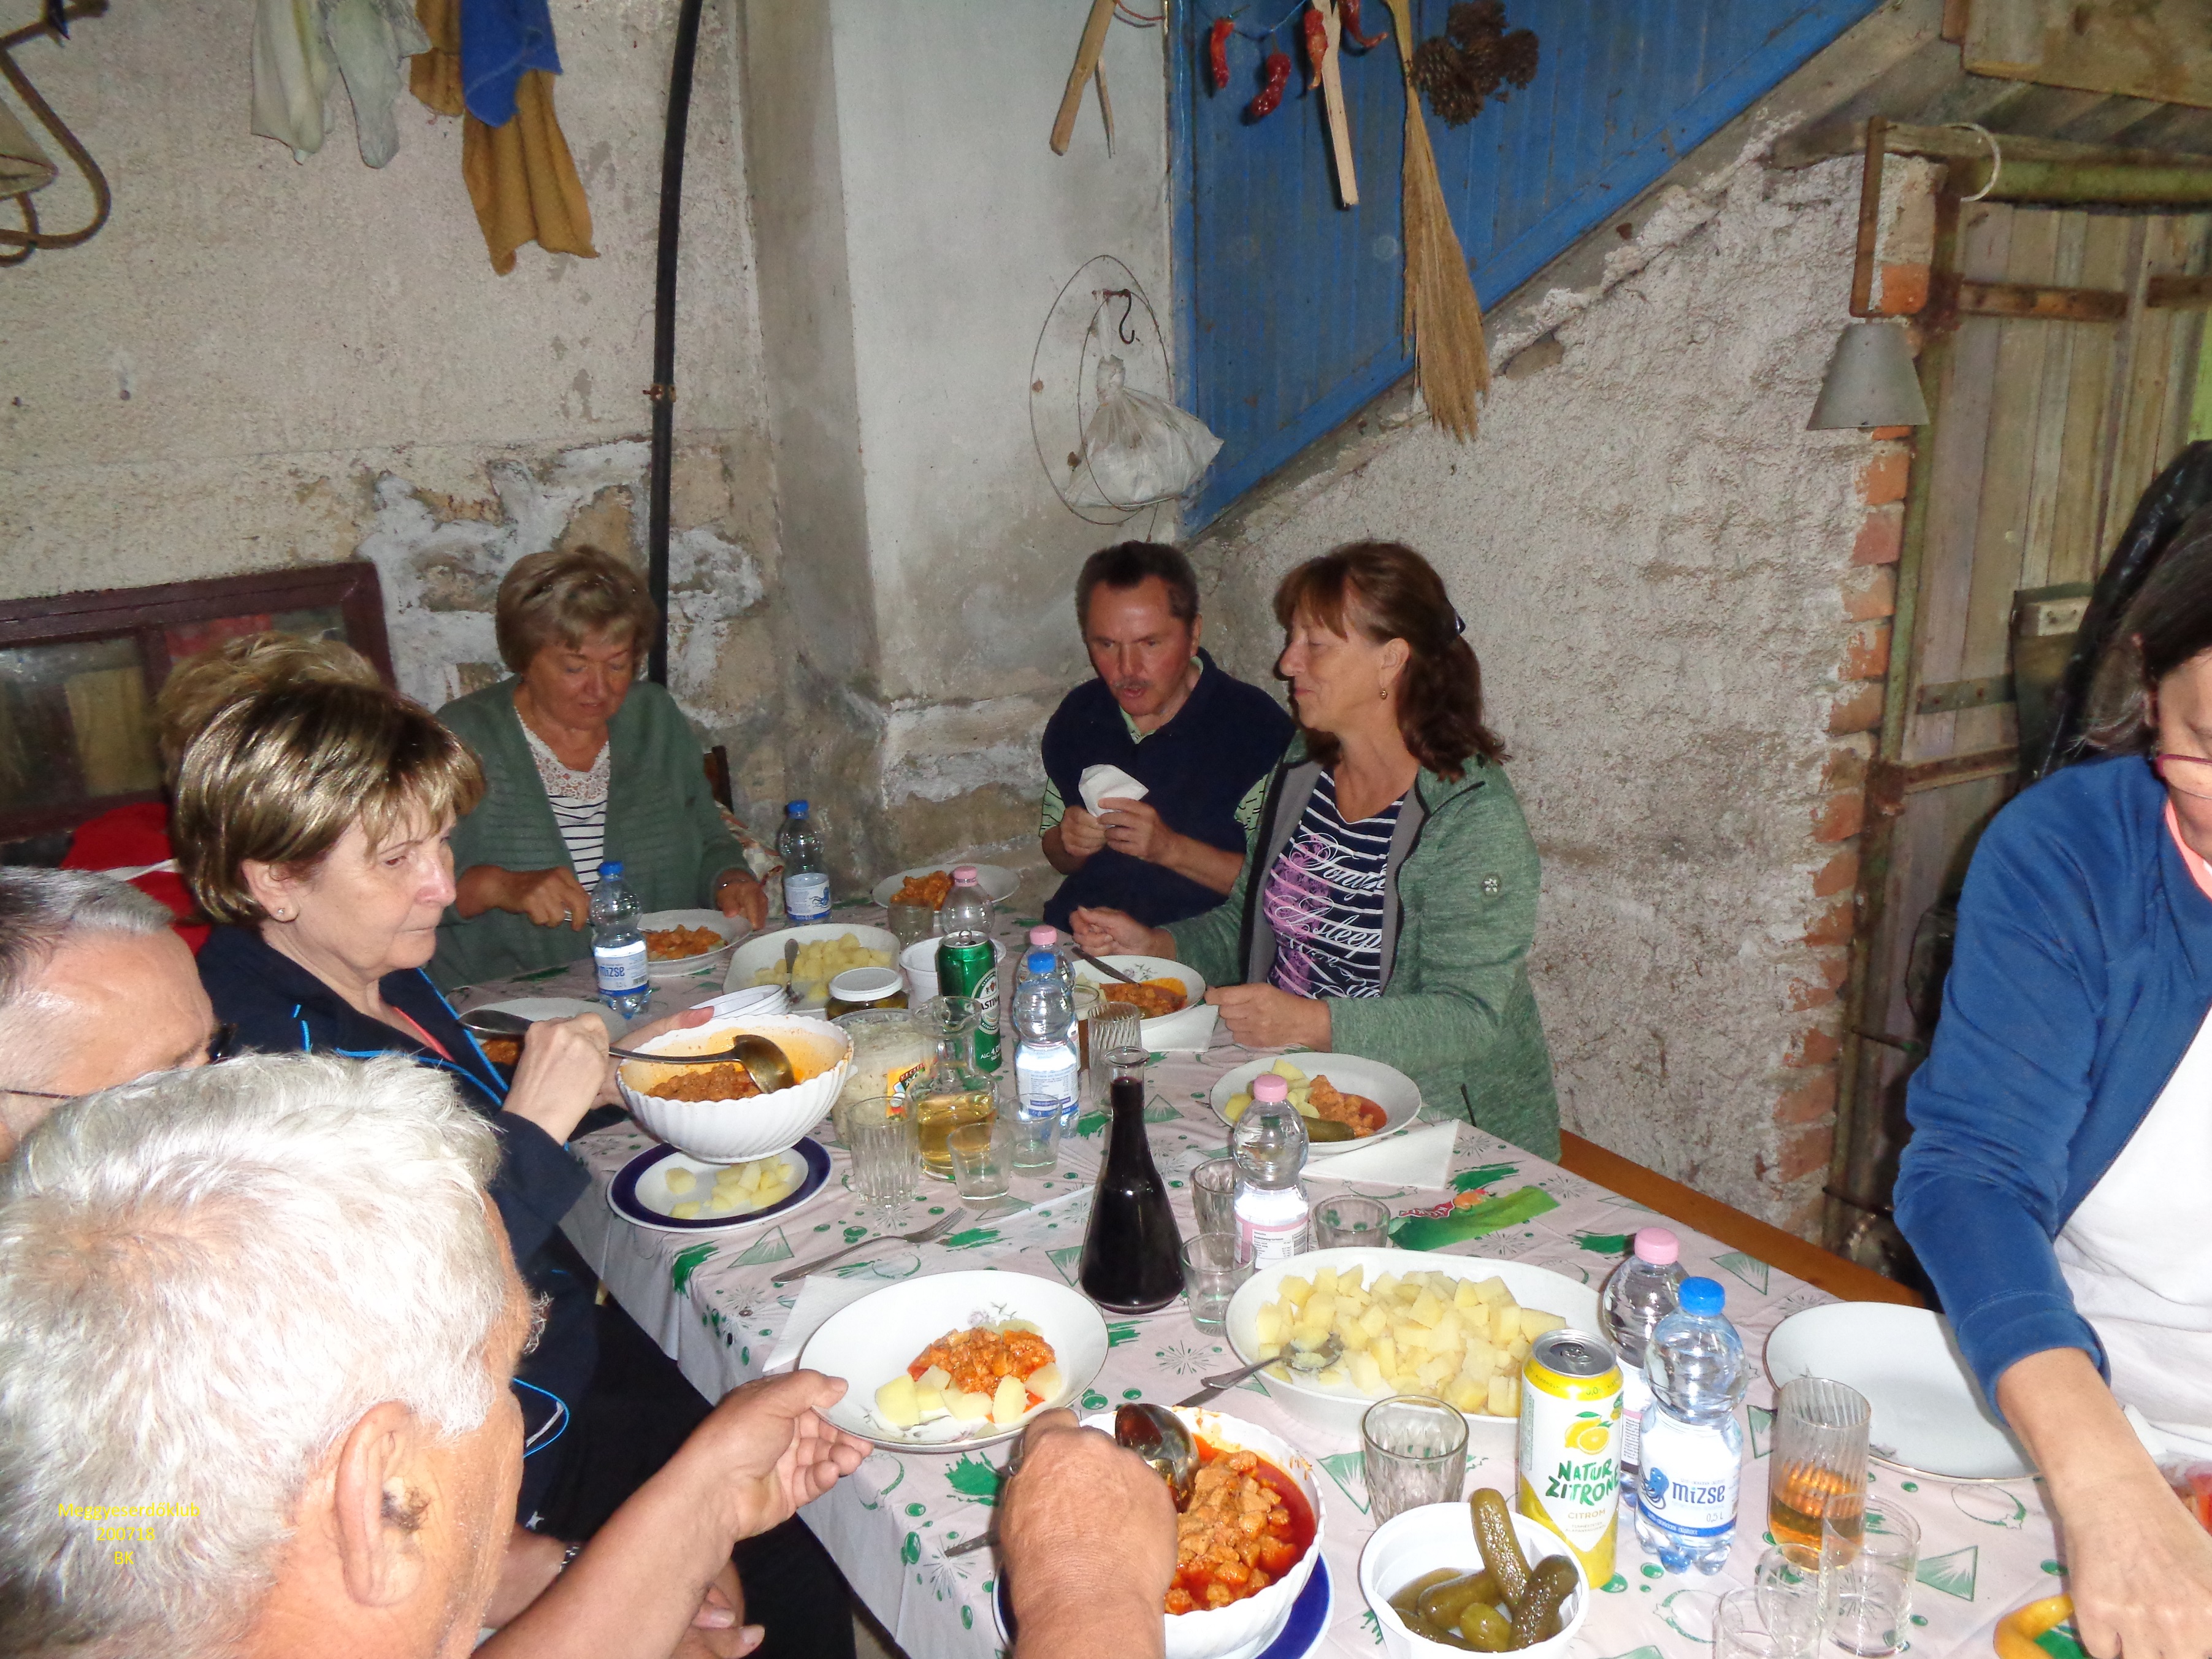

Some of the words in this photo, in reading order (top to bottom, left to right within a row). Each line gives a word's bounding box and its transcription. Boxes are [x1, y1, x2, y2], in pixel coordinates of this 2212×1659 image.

[1312, 914, 1382, 959] sleep
[1558, 1458, 1613, 1482] NATUR
[1672, 1482, 1726, 1504] mizse
[1568, 1508, 1605, 1519] CITROM
